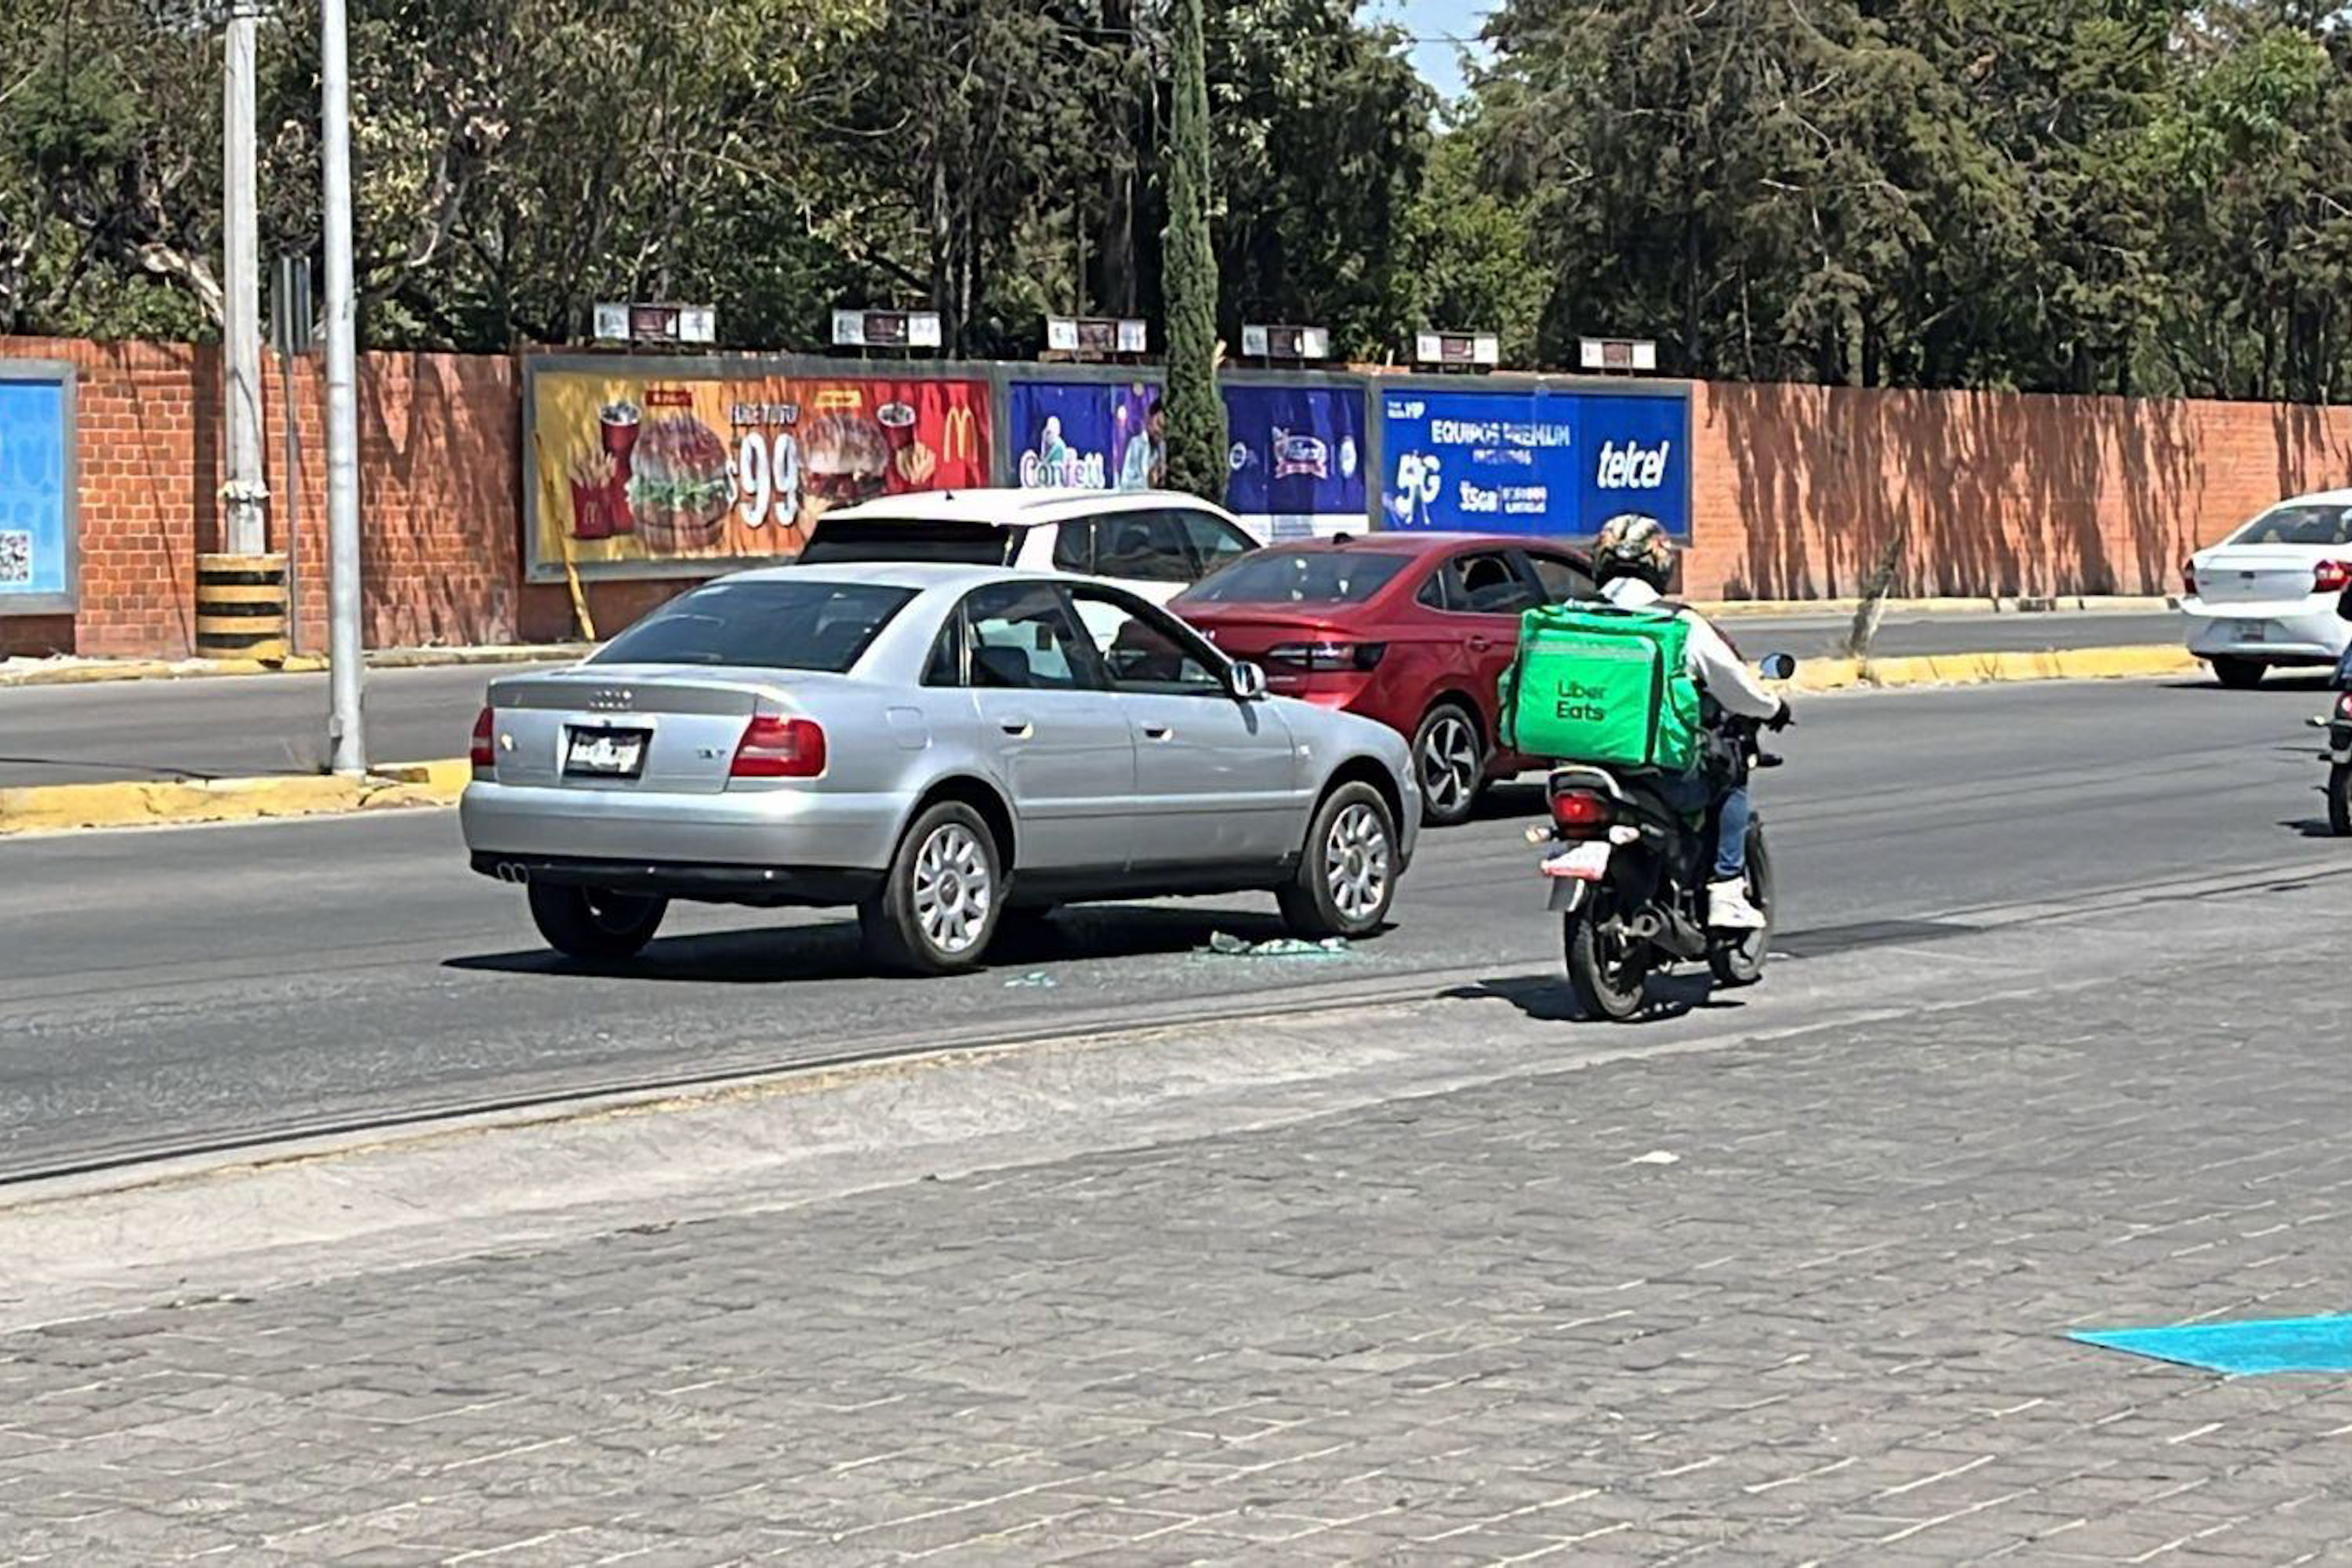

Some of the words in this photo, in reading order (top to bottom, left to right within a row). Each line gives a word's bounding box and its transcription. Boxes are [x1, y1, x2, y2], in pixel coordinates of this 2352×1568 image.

[1431, 419, 1501, 446] EQUIPOS
[1597, 440, 1670, 488] telcel
[1395, 453, 1441, 515] 5G
[1558, 679, 1607, 700] Uber
[1557, 701, 1605, 721] Eats
